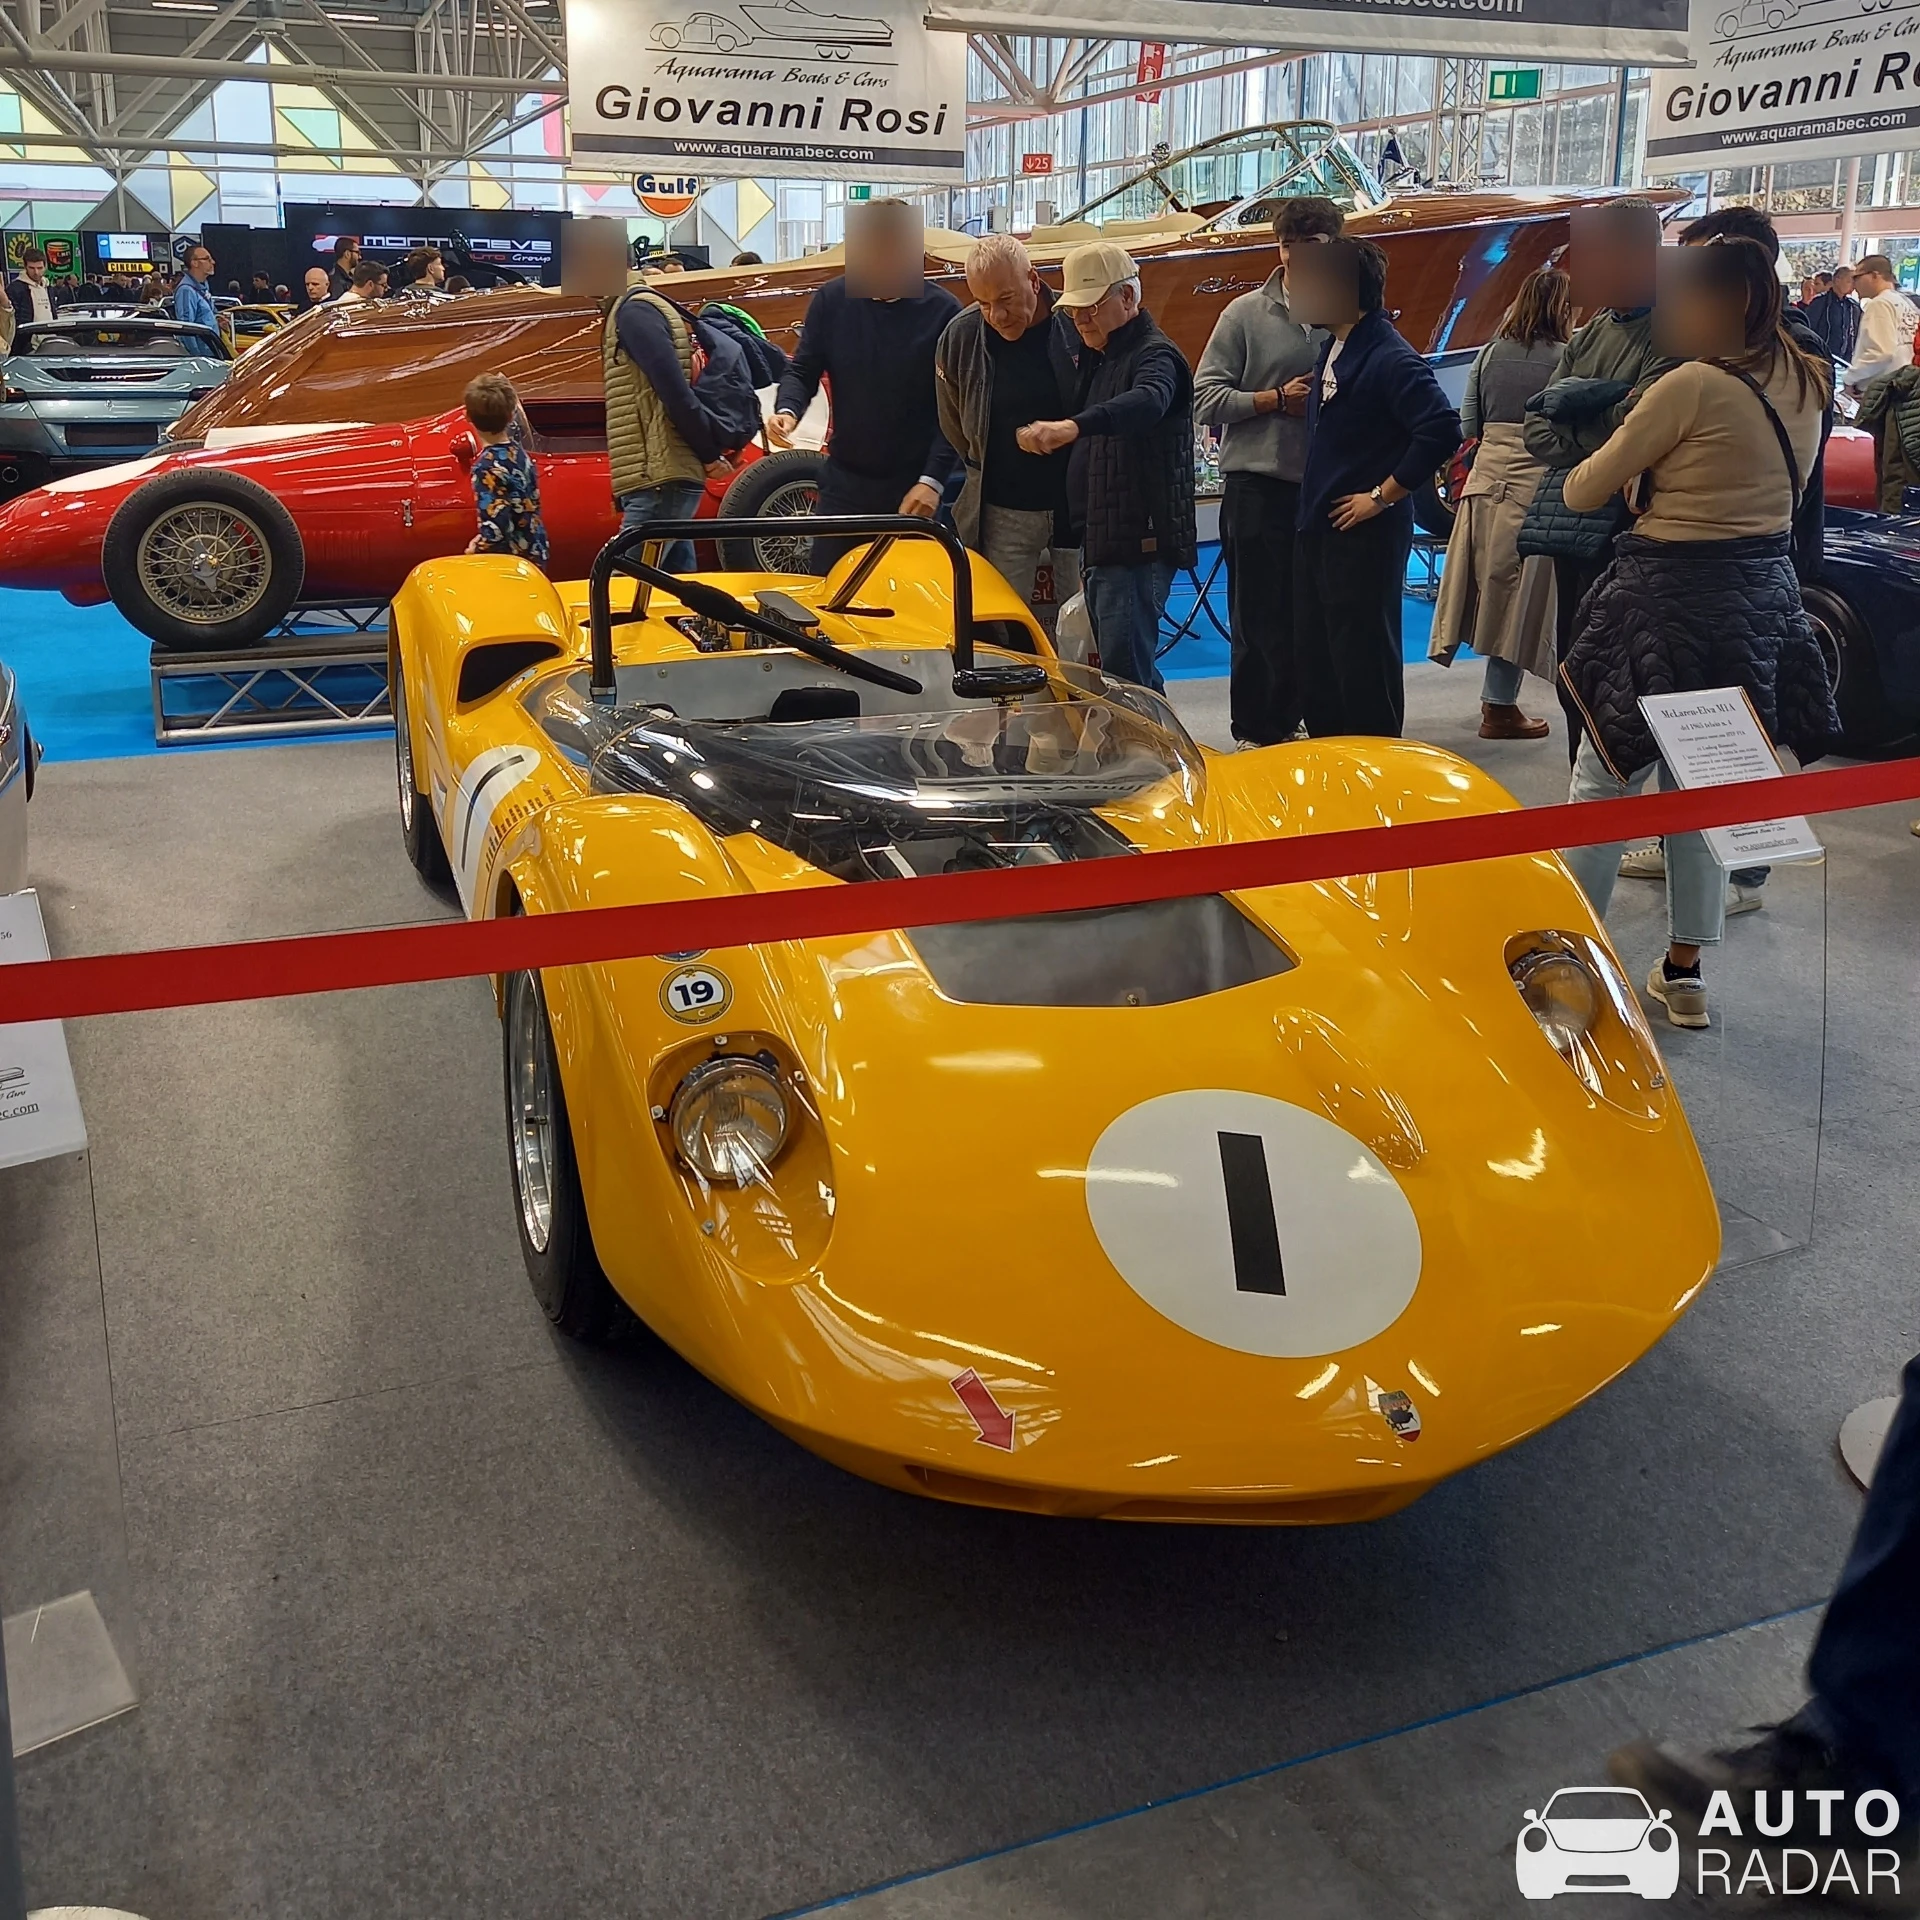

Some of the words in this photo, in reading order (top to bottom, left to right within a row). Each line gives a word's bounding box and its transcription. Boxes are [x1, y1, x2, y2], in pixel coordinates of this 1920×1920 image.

[1713, 37, 1818, 72] Aquarama
[1822, 29, 1871, 50] Boats
[1874, 21, 1892, 41] &
[653, 57, 777, 83] Aquarama
[781, 67, 832, 85] Boats
[834, 72, 850, 85] &
[853, 72, 890, 88] Cars
[1666, 58, 1862, 122] Giovanni
[595, 84, 824, 129] Giovanni
[839, 98, 947, 135] Rosi
[1721, 112, 1907, 145] www.aquaramabec.com
[674, 141, 875, 161] www.aquaramabec.com
[1036, 159, 1049, 169] 25
[637, 174, 697, 194] Gulf
[110, 263, 143, 272] CINEMA
[512, 254, 551, 263] Group
[1661, 706, 1716, 718] McLaren-Elva
[674, 980, 714, 1007] 19
[698, 1008, 706, 1017] C
[1217, 1131, 1287, 1296] 1
